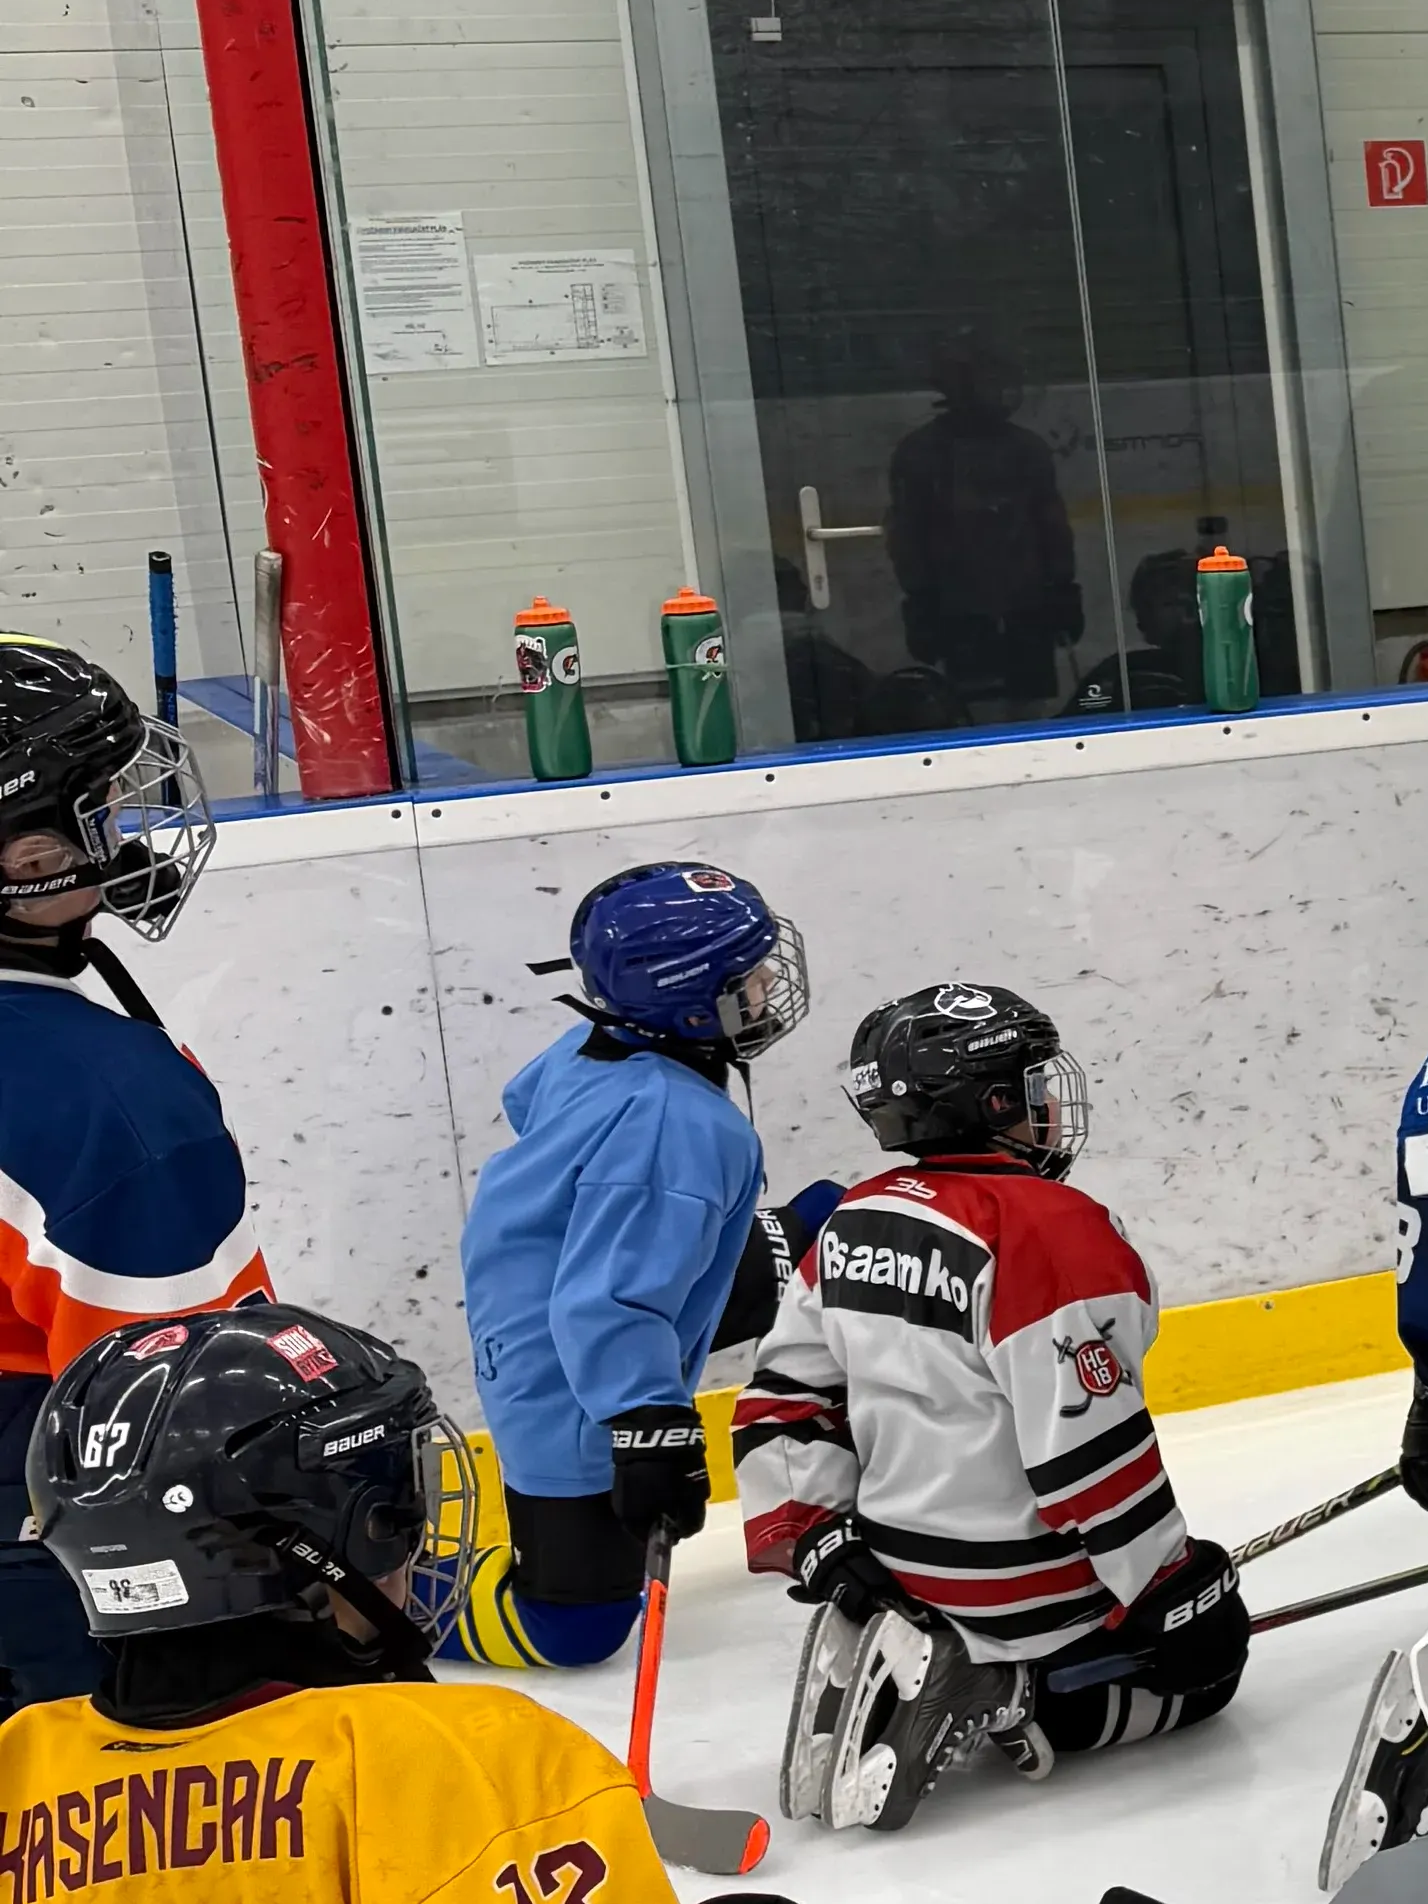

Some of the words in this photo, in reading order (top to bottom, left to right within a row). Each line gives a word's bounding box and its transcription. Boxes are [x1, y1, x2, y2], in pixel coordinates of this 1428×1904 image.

[1083, 1342, 1109, 1368] HC
[1092, 1367, 1111, 1387] 18
[84, 1421, 131, 1469] 67
[323, 1424, 386, 1457] BAUER
